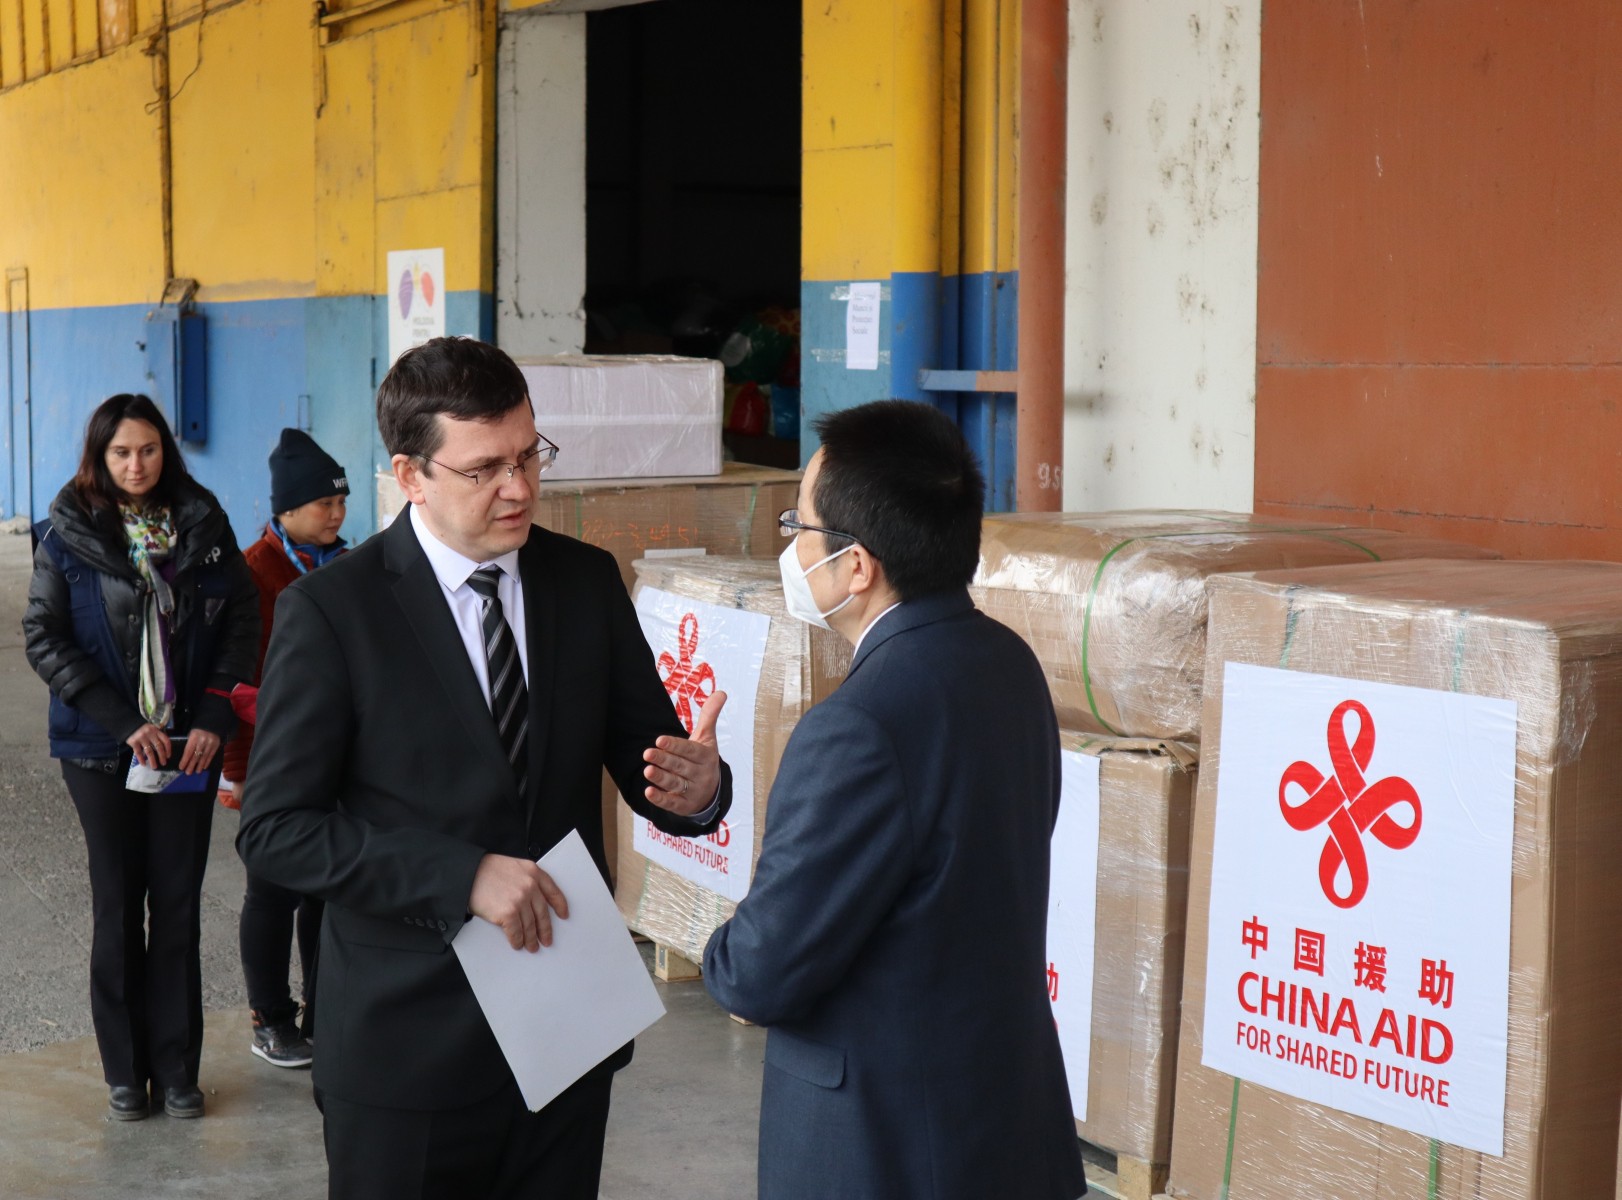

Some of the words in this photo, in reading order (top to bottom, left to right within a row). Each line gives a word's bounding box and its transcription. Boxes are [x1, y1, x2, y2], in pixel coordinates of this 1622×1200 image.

[663, 832, 693, 858] SHARED
[695, 844, 729, 875] FUTURE
[1241, 915, 1455, 1010] 中国援助
[1237, 971, 1363, 1045] CHINA
[1369, 1007, 1454, 1065] AID
[1236, 1021, 1272, 1055] FOR
[1276, 1033, 1358, 1080] SHARED
[1364, 1059, 1450, 1108] FUTURE
